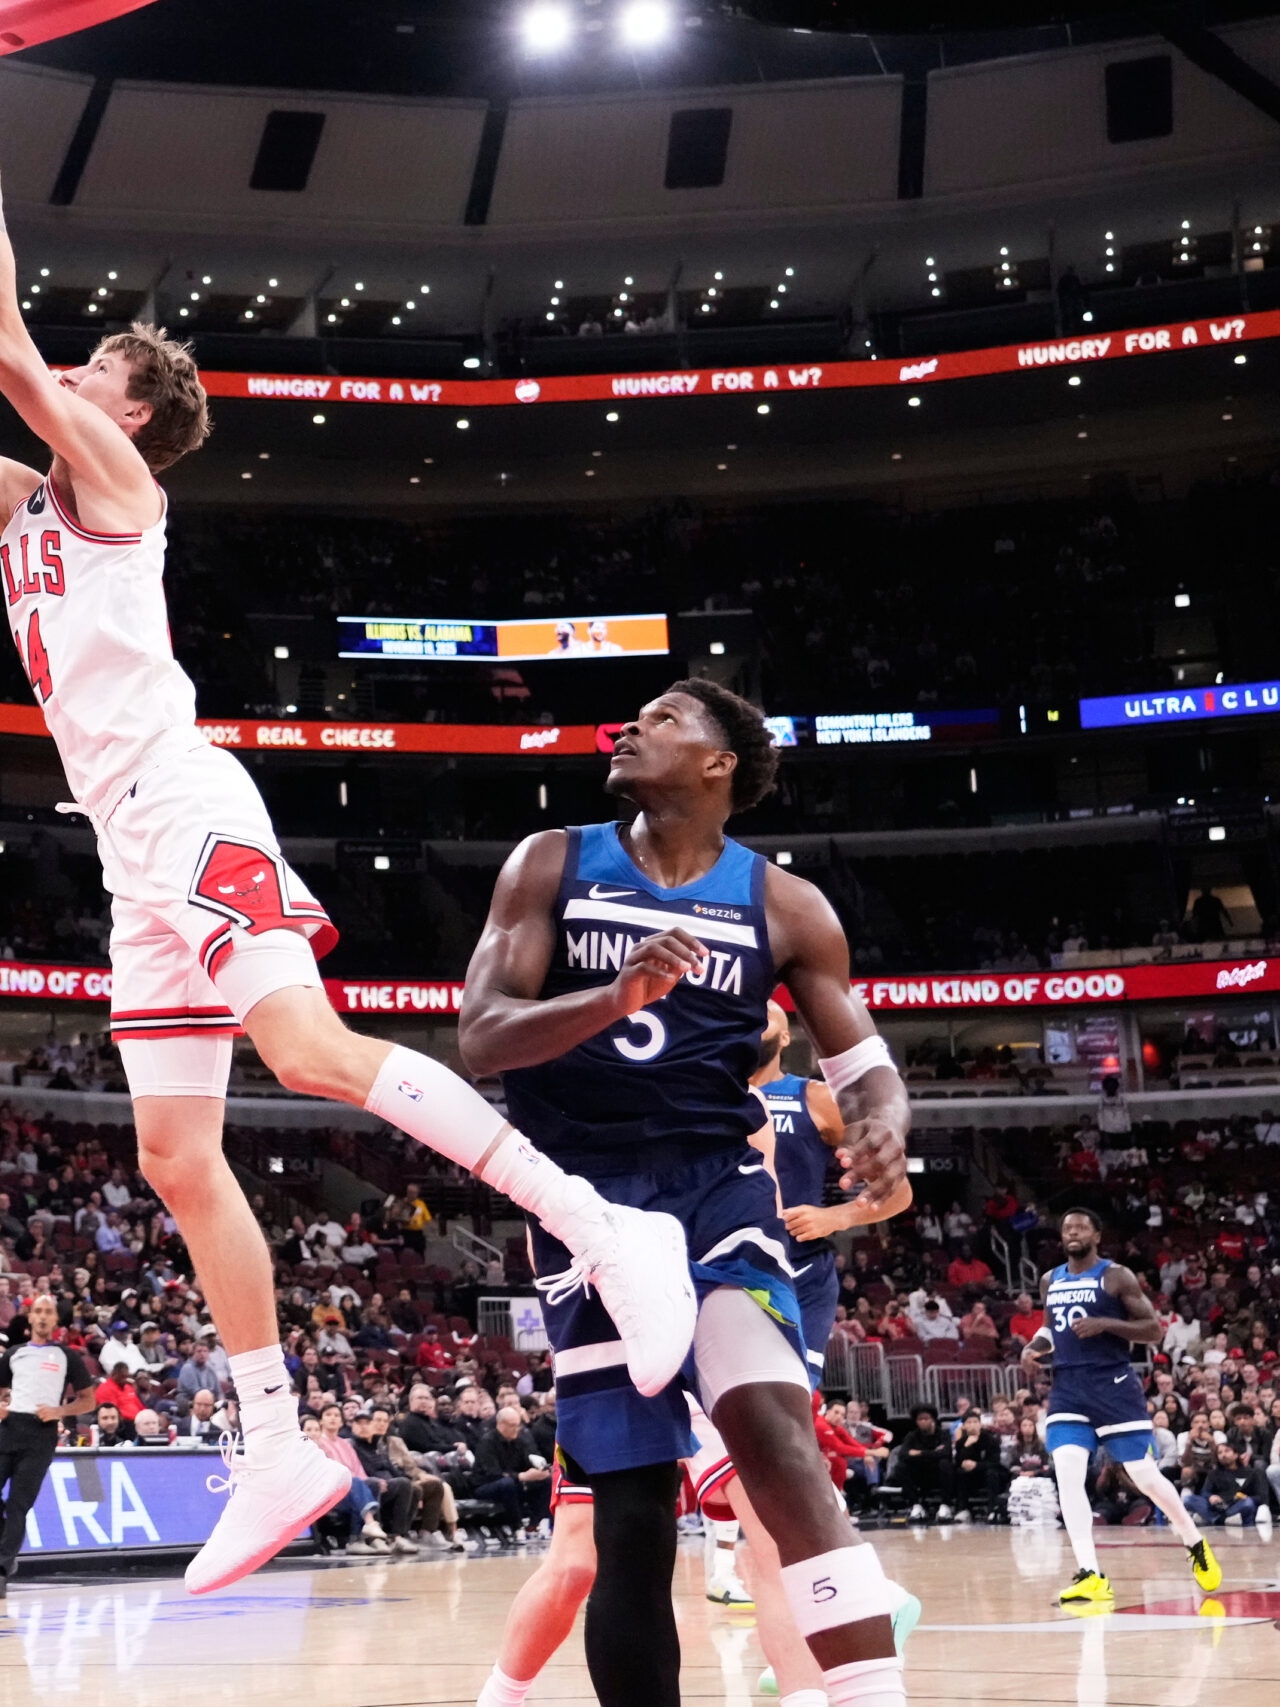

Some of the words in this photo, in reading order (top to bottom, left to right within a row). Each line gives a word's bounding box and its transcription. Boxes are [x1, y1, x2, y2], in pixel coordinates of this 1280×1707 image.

[1017, 337, 1111, 366] HUNGRY
[1125, 330, 1171, 353] FOR
[1182, 326, 1198, 345] A
[1209, 319, 1246, 340] W?
[247, 377, 331, 398] HUNGRY
[340, 381, 380, 400] FOR
[389, 382, 404, 400] A
[410, 384, 442, 402] W?
[611, 373, 700, 396] HUNGRY
[711, 371, 754, 392] FOR
[763, 369, 778, 388] A
[788, 367, 822, 387] W?
[0, 530, 65, 606] LLS
[15, 608, 53, 704] 4
[1125, 695, 1196, 718] ULTRA
[1222, 682, 1278, 709] CLU
[256, 726, 308, 746] REAL
[320, 728, 396, 748] CHEESE
[816, 730, 842, 744] NEW
[842, 728, 871, 743] YORK
[702, 907, 742, 921] sezzle
[47, 971, 82, 996] OF
[83, 972, 112, 997] GO
[873, 981, 927, 1006] FUN
[933, 979, 1000, 1004] KIND
[1004, 977, 1040, 1001] OF
[1044, 973, 1124, 1000] GOOD
[343, 986, 394, 1009] THE
[396, 986, 448, 1009] FUN
[812, 1577, 837, 1603] 5
